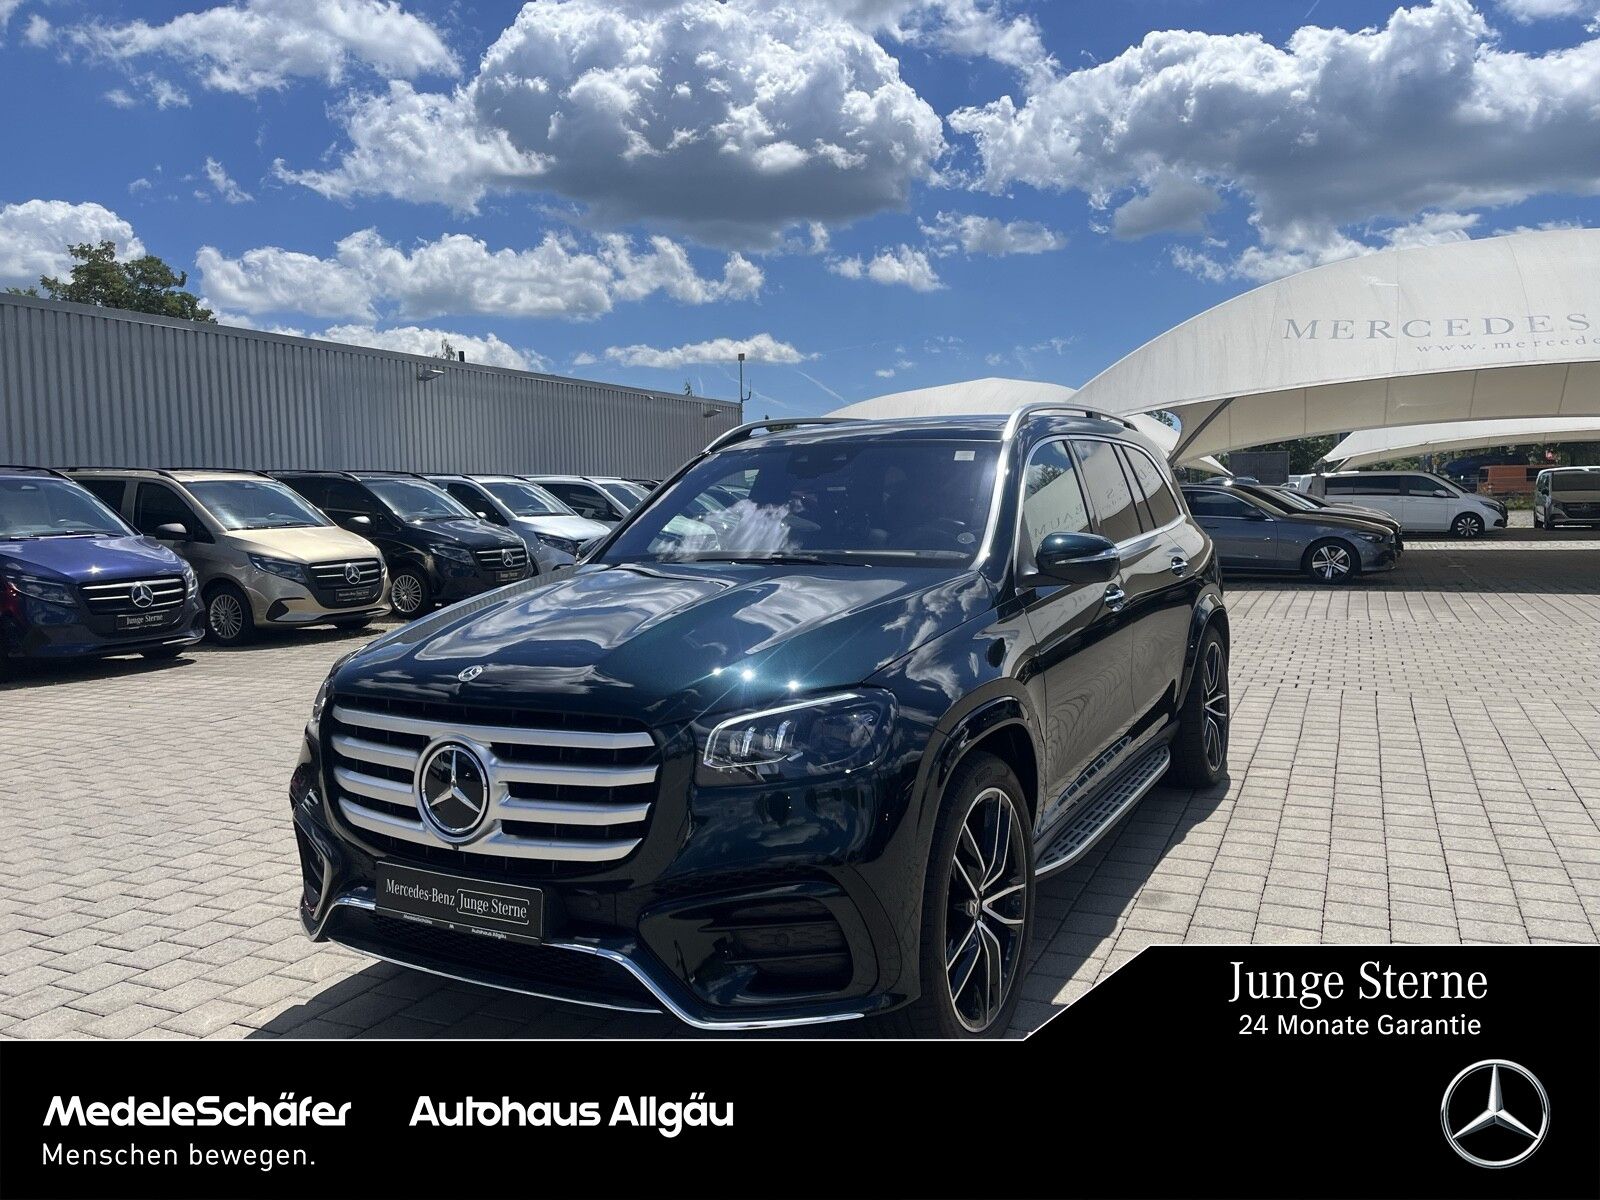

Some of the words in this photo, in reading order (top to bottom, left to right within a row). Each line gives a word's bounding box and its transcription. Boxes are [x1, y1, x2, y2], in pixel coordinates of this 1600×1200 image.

[1283, 313, 1590, 340] MERCEDES
[385, 878, 455, 906] Mercedes-Benz
[459, 893, 489, 914] Junge
[491, 898, 527, 919] Sterne
